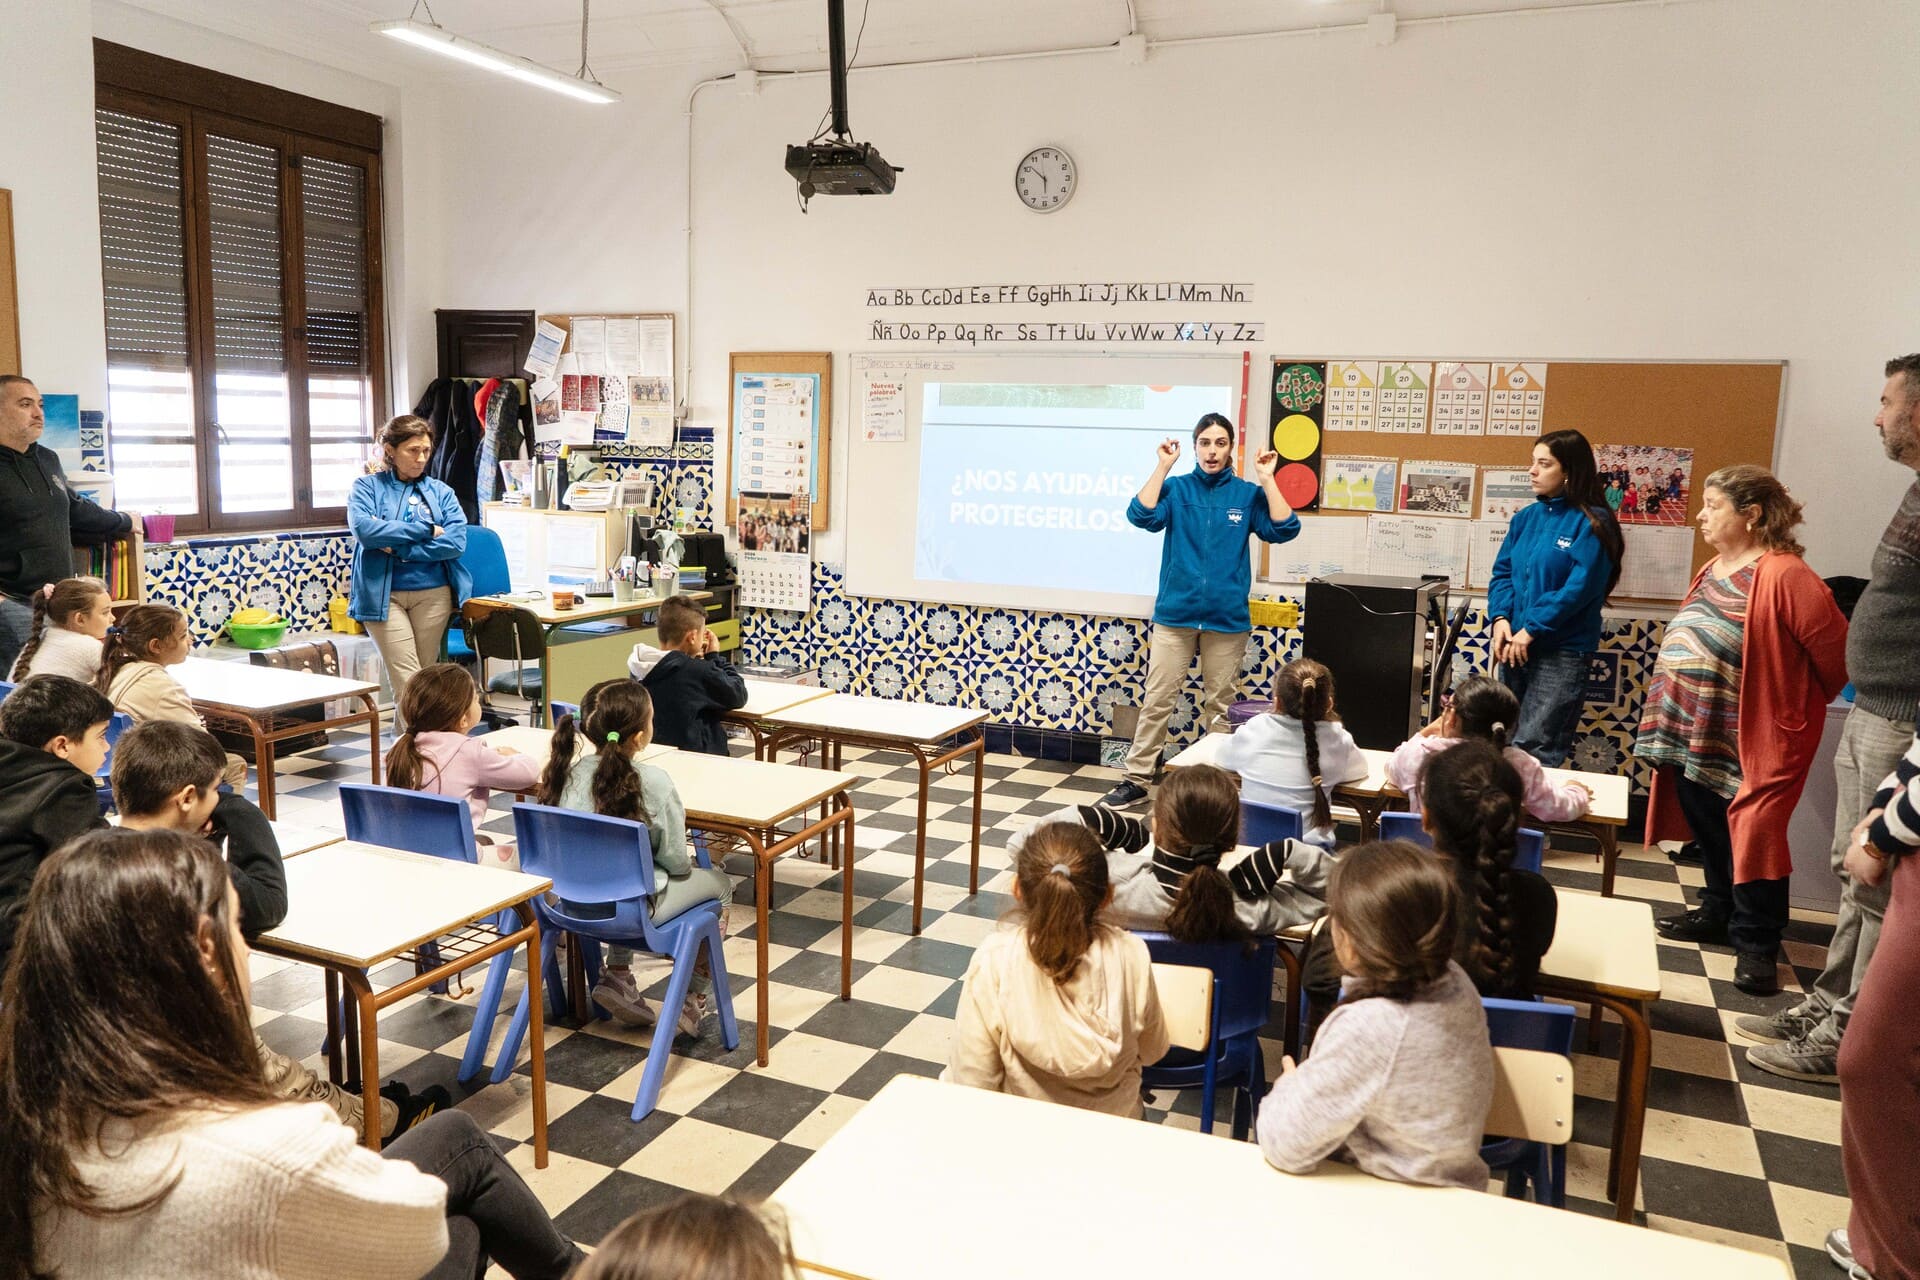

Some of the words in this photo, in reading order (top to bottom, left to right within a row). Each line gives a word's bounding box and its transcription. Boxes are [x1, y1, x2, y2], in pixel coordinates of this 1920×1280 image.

[867, 291, 886, 306] Aa
[894, 289, 914, 305] Bb
[971, 286, 990, 304] Ee
[999, 286, 1018, 303] Ff
[1078, 284, 1092, 301] Ii
[1101, 284, 1118, 306] Jj
[1127, 284, 1148, 301] Kk
[1180, 284, 1212, 301] Mm
[1222, 284, 1244, 301] Nn
[873, 320, 892, 340] Ññ
[900, 324, 920, 340] Oo
[928, 324, 946, 344] Pp
[954, 324, 976, 346] Qq
[984, 324, 1004, 340] Rr
[1018, 324, 1037, 340] Ss
[1046, 324, 1066, 340] Tt
[1074, 324, 1095, 340] Uu
[1105, 324, 1126, 340] Vv
[1130, 324, 1164, 340] Ww
[1174, 324, 1194, 340] Xx
[1202, 324, 1224, 344] Yy
[1234, 324, 1256, 340] Zz
[950, 469, 1016, 496] ¿NOS
[1022, 467, 1135, 497] AYUDÁIS
[949, 502, 1134, 533] PROTEGERLOS
